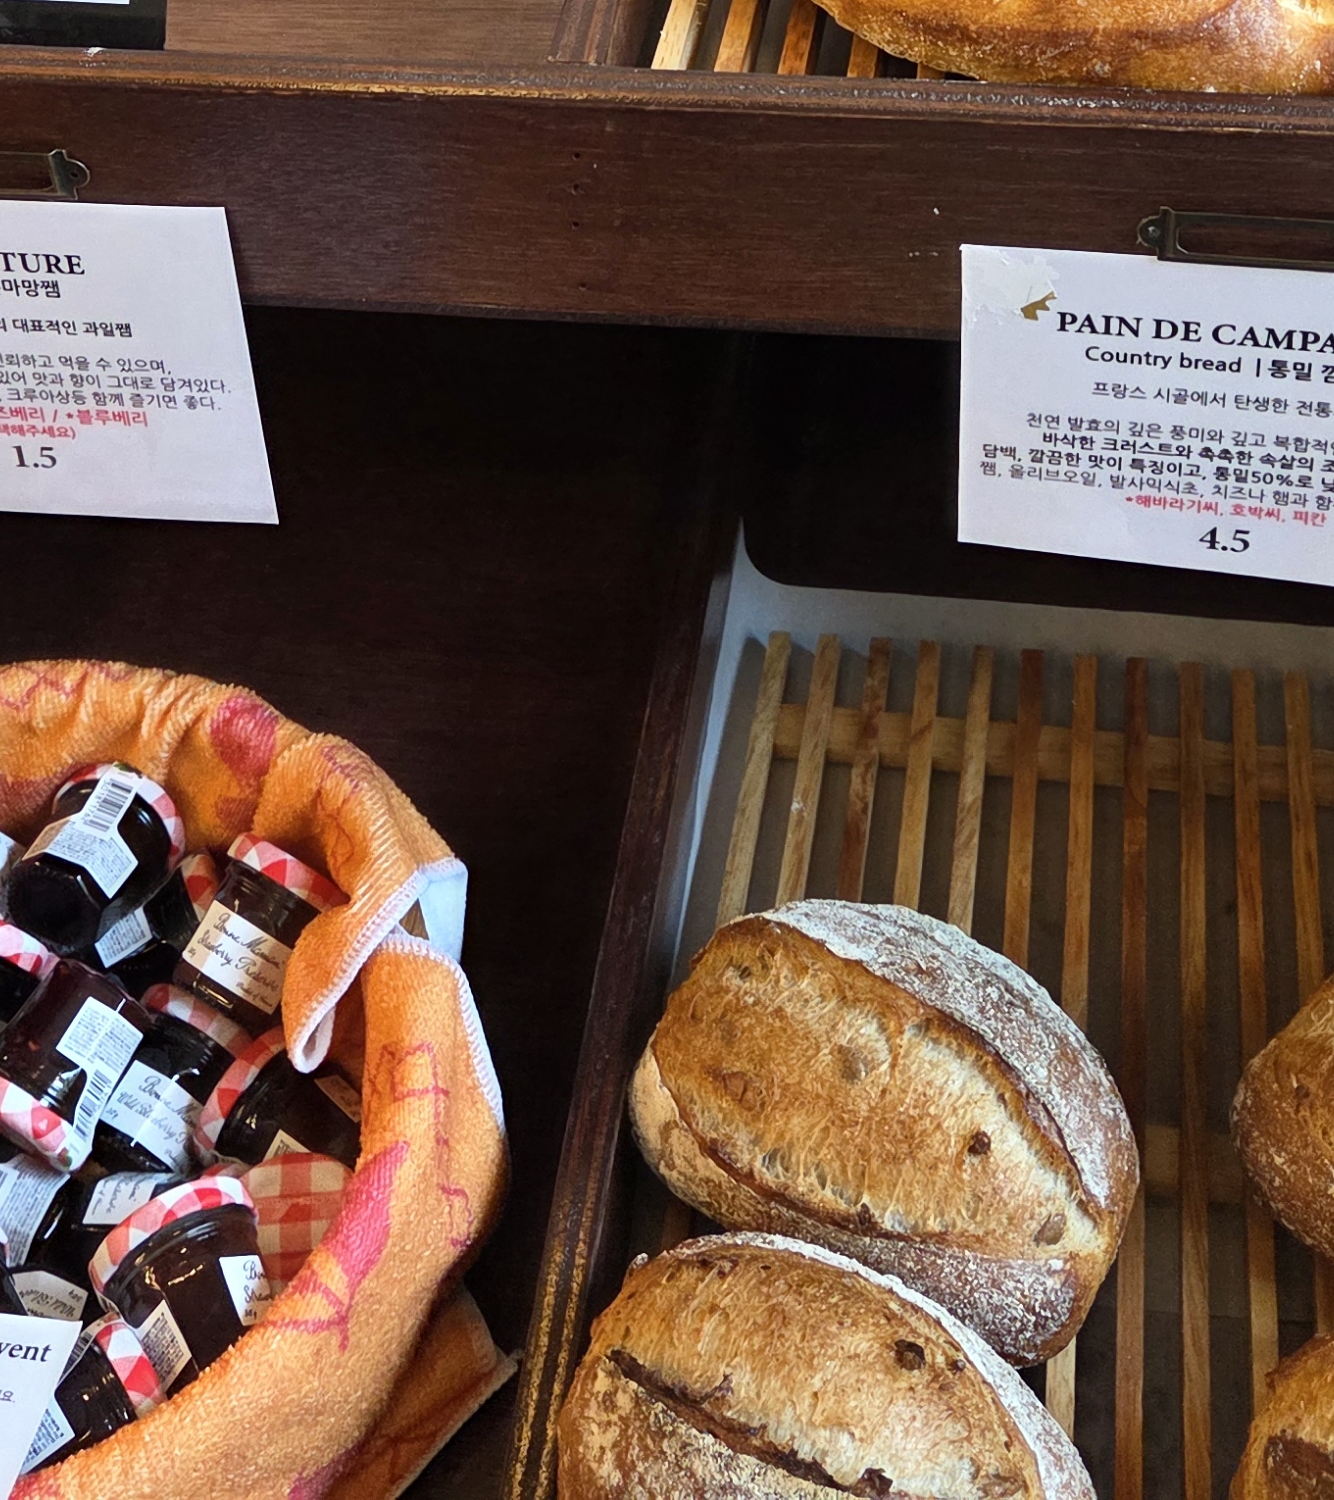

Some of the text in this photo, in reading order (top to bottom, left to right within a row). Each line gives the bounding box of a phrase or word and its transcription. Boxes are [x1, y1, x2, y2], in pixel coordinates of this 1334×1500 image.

[12, 318, 77, 335] 대표적인
[1057, 311, 1143, 337] PAIN
[1151, 318, 1201, 342] DE
[58, 355, 90, 371] 먹을
[95, 357, 112, 371] 수
[116, 358, 171, 375] 있으며,
[1085, 346, 1172, 369] Country
[1179, 351, 1241, 372] bread
[1267, 359, 1312, 381] 통밀
[7, 388, 86, 405] 크루아상등
[91, 391, 124, 407] 함께
[129, 392, 177, 409] 즐기면
[183, 395, 221, 410] 좋다.
[1092, 382, 1146, 399] 프랑스
[1153, 387, 1226, 408] 시골에서
[1234, 394, 1289, 413] 탄생한
[1026, 412, 1059, 430] 천연
[1067, 416, 1119, 435] 발효의
[1128, 421, 1162, 439] 깊은
[1231, 431, 1266, 447] 깊고
[12, 445, 56, 468] 1.5
[982, 443, 1021, 462] 담백,
[1028, 448, 1081, 467] 깔끔한
[1088, 454, 1122, 471] 맛이
[1129, 458, 1206, 480] 특징이고,
[1212, 466, 1313, 488] 통밀50%로
[1042, 432, 1095, 450] 바삭한
[1101, 437, 1193, 459] 크러스트와
[1198, 446, 1254, 466] 촉촉한
[1259, 452, 1314, 472] 속살의
[1008, 464, 1101, 487] 올리브오일,
[1109, 474, 1203, 498] 발사믹식초,
[1211, 484, 1265, 503] 치즈나
[1272, 490, 1309, 508] 햄과
[1229, 503, 1285, 522] 호박씨,
[1292, 510, 1326, 527] 피칸
[1198, 526, 1250, 552] 4.5
